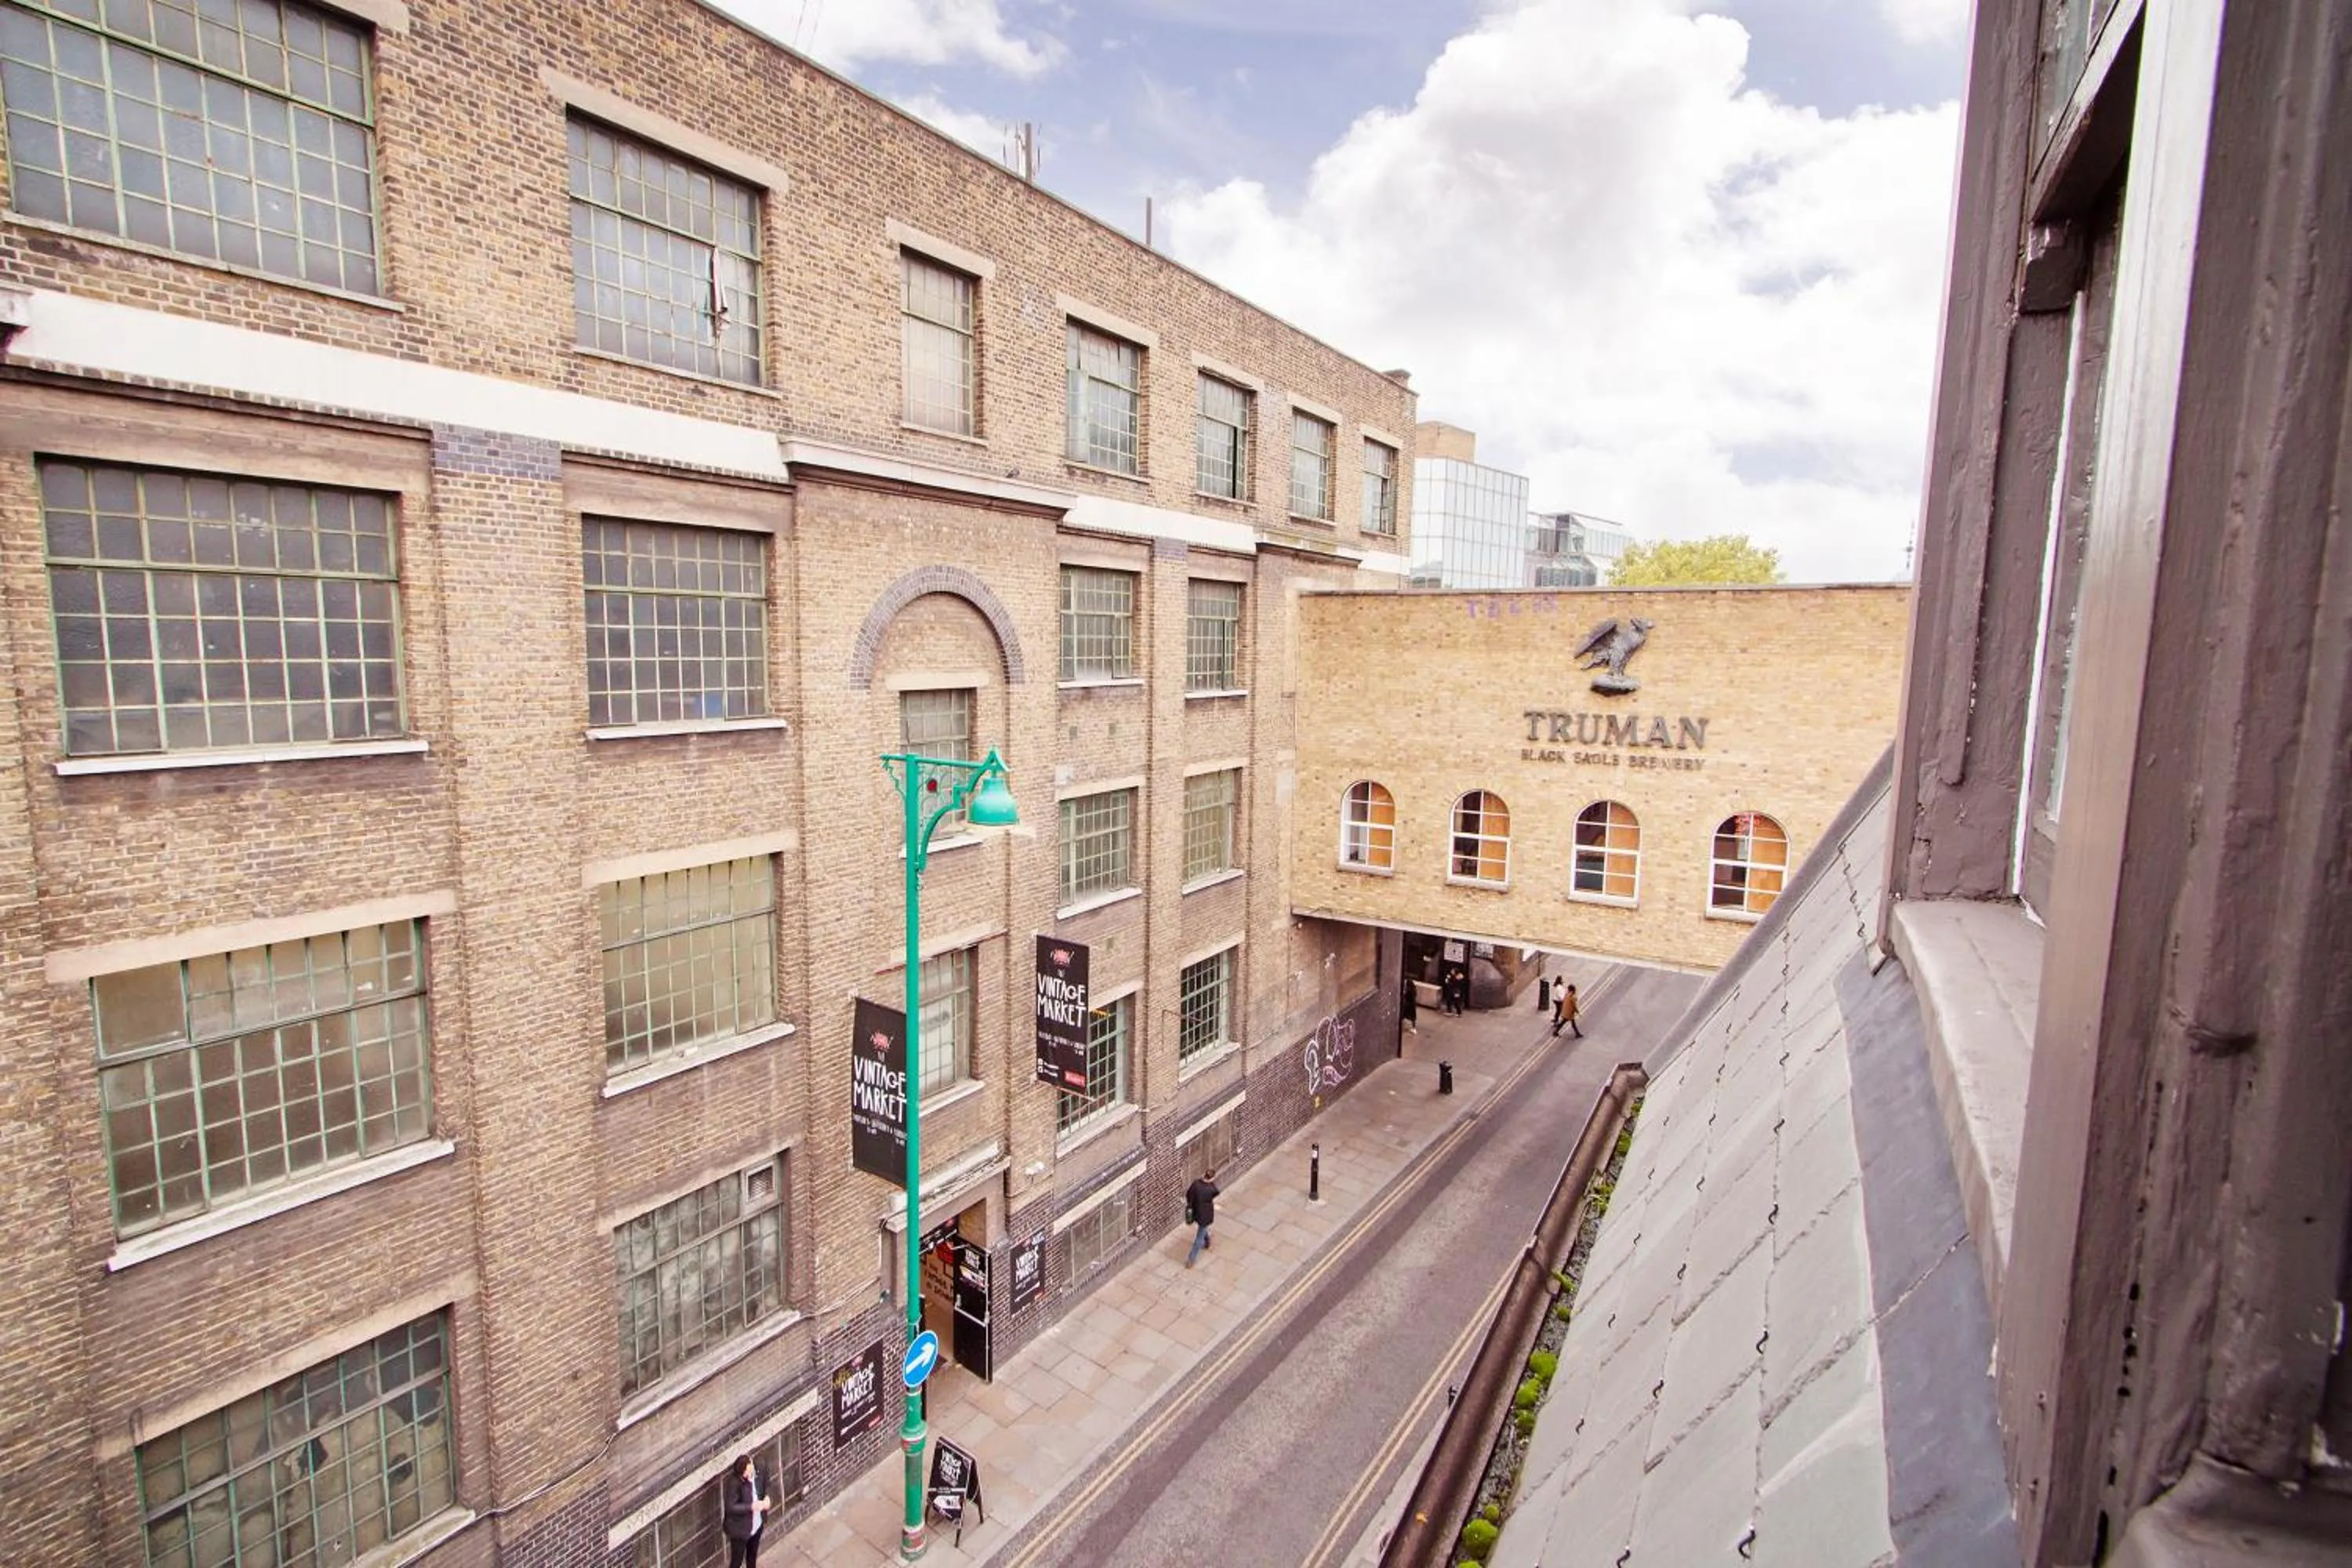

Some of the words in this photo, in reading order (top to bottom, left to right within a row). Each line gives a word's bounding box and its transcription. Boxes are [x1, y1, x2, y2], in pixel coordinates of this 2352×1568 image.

[1523, 710, 1710, 750] TRUMAN
[1521, 749, 1566, 764] BLACK
[1628, 755, 1706, 771] BREWERY
[1036, 972, 1086, 1007] VINTAGE
[1037, 993, 1087, 1028] MARKET
[854, 1054, 906, 1098] VINTAGE
[853, 1080, 907, 1123] MARKET
